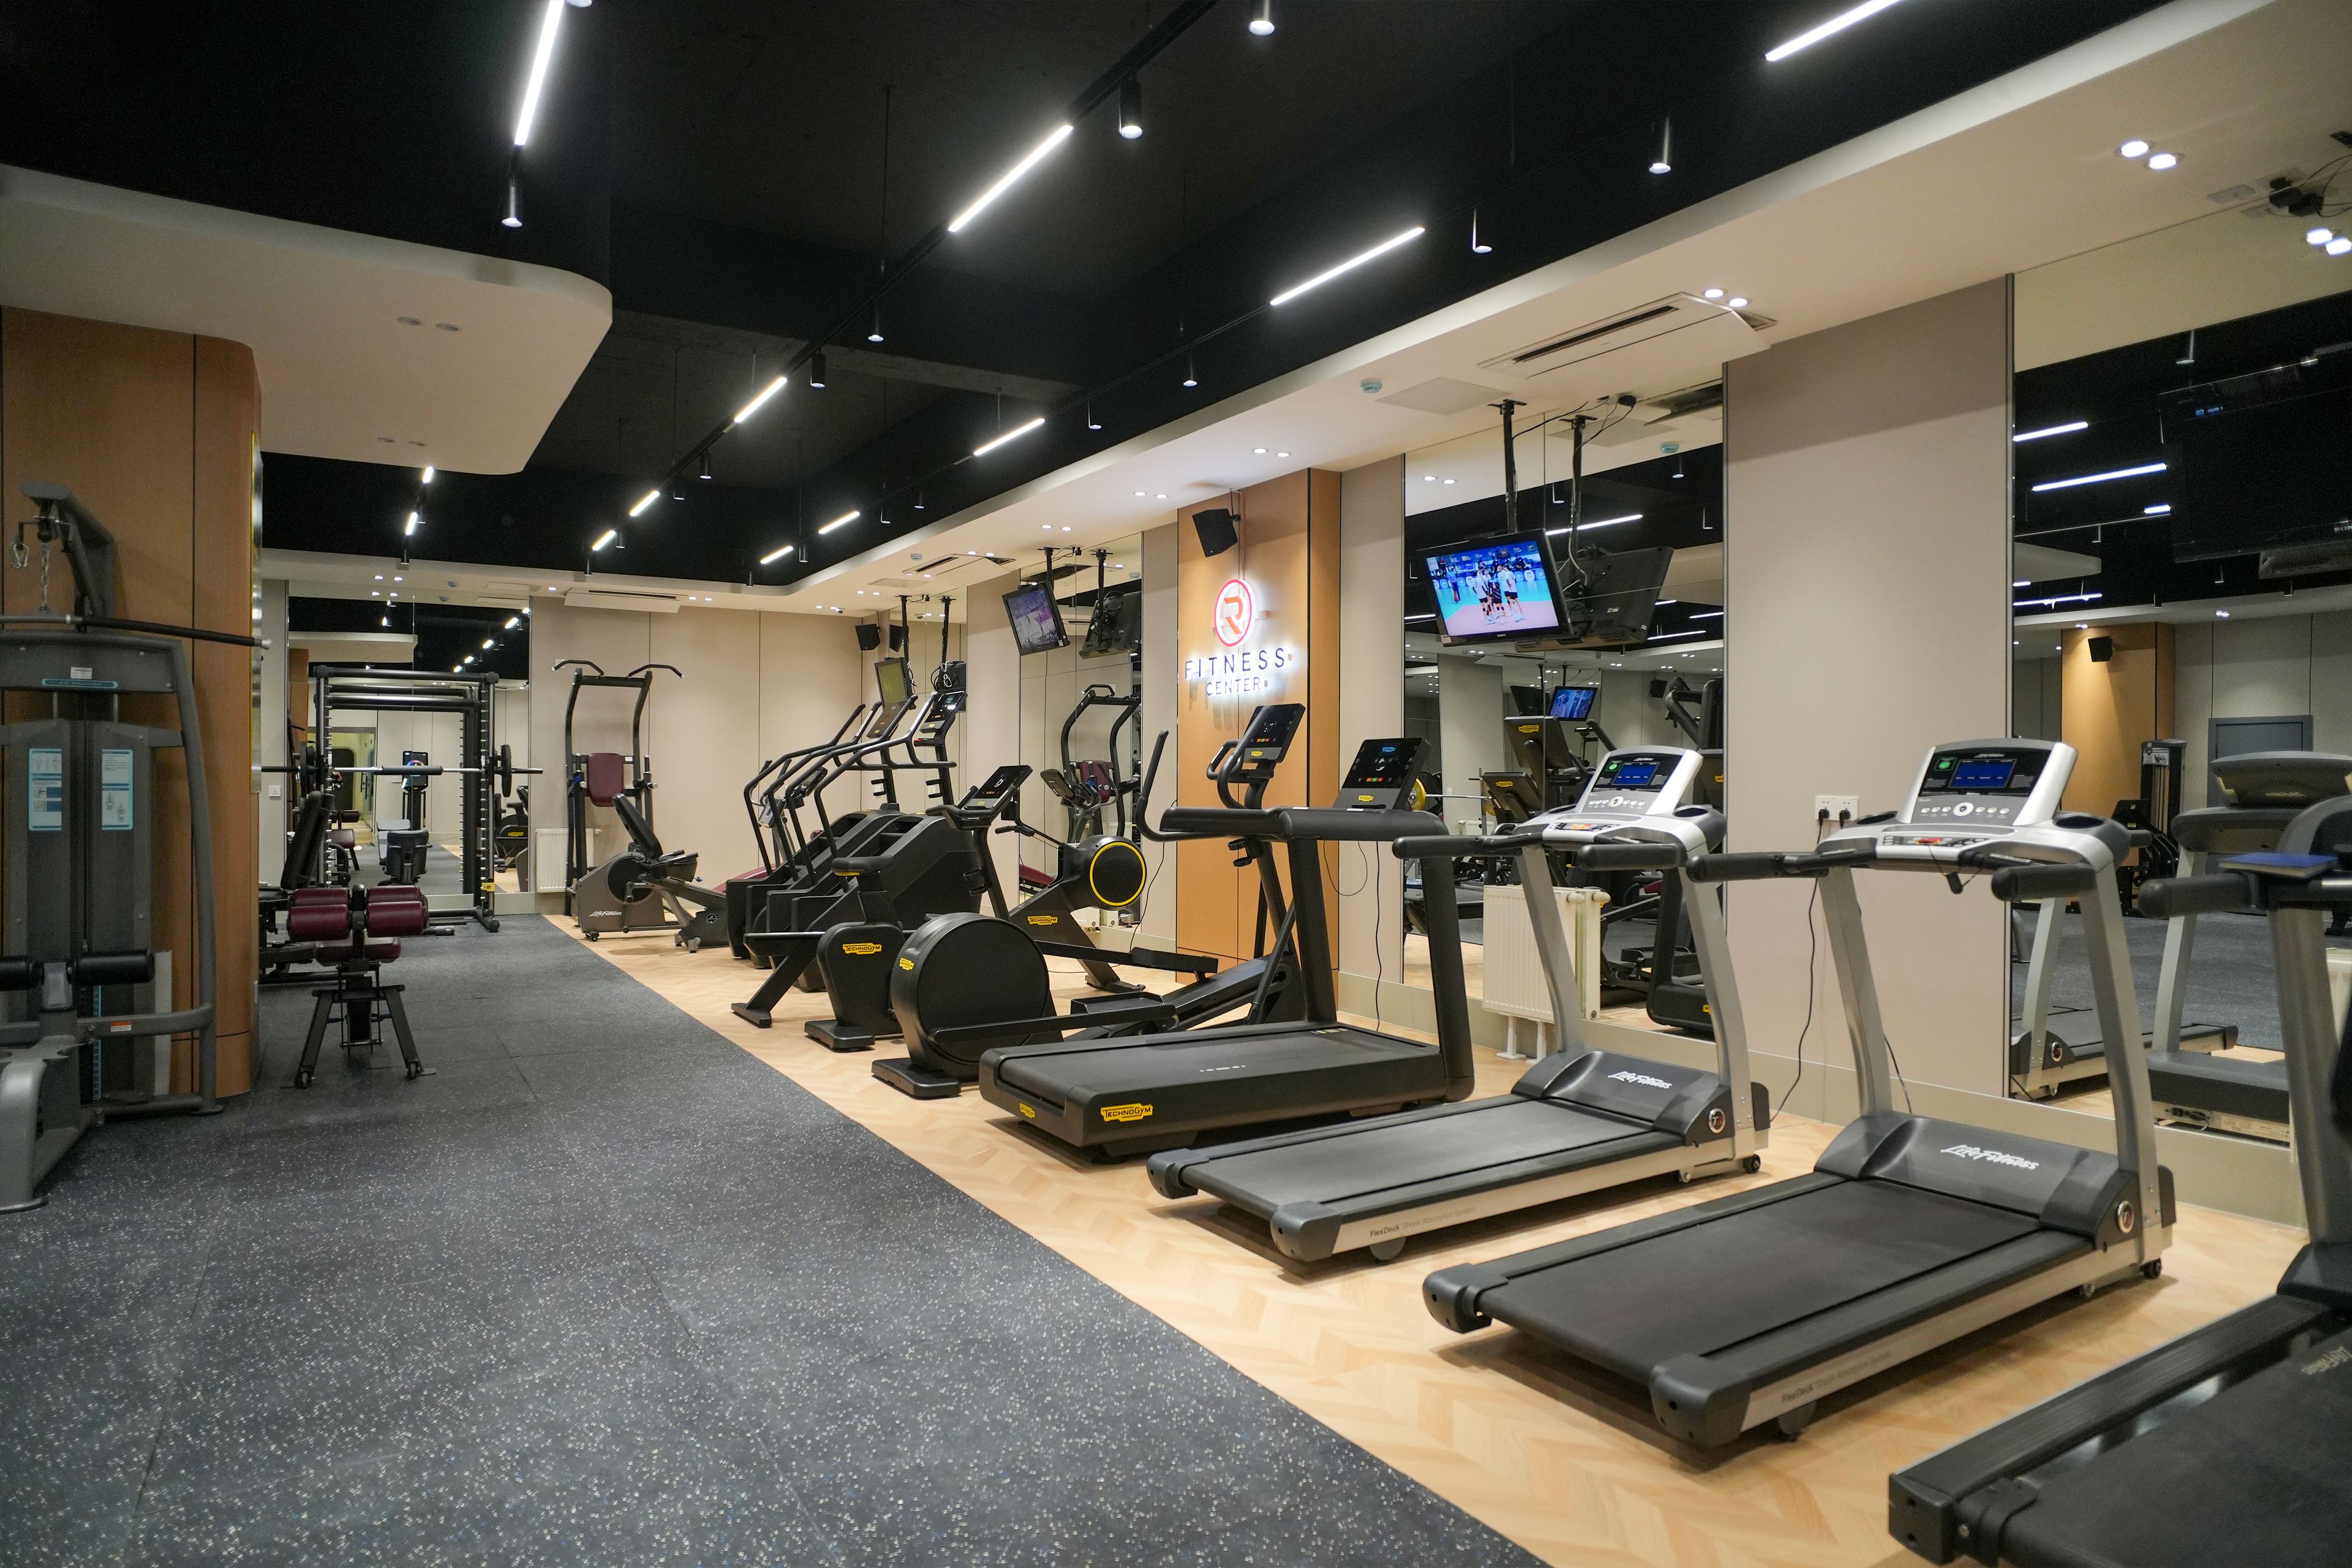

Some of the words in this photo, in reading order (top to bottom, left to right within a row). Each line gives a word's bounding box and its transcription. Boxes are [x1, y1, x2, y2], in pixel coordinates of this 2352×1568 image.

[1185, 647, 1285, 679] FITNESS
[1205, 676, 1261, 696] CENTER
[1102, 1105, 1152, 1119] TECHNOGYM
